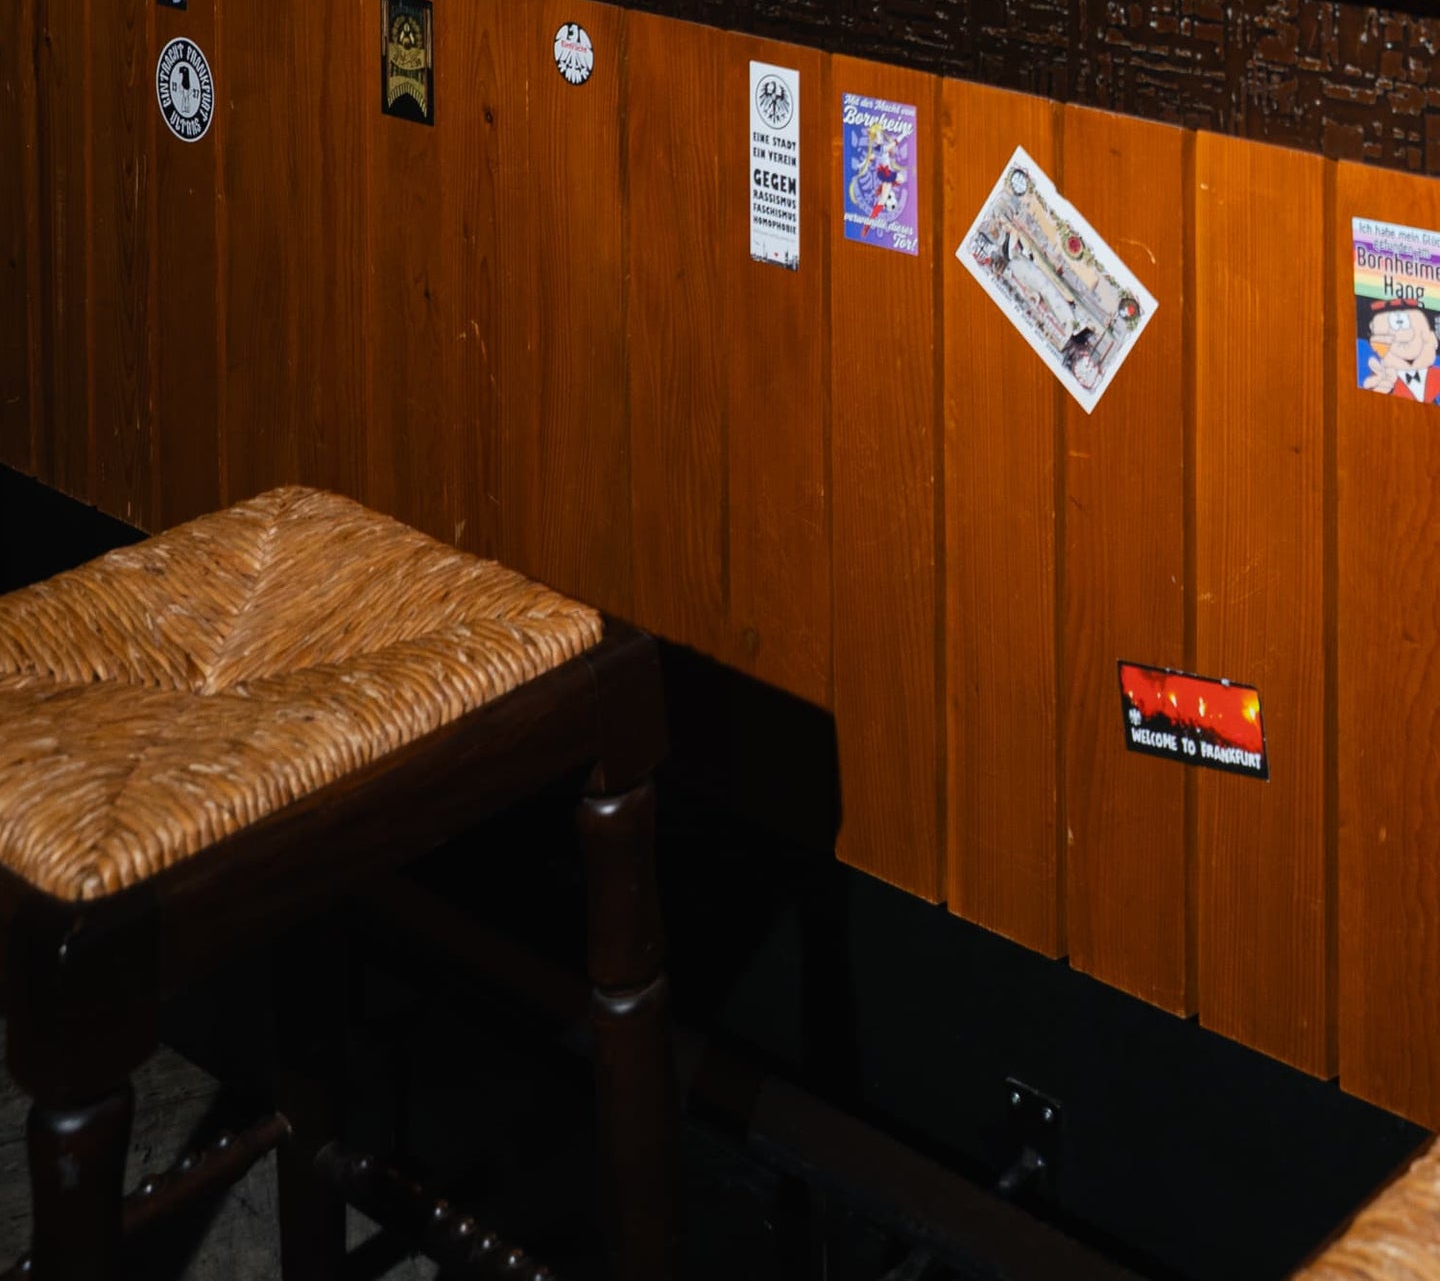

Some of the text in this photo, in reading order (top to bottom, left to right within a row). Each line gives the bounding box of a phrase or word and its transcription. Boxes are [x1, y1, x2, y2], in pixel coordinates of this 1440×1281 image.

[159, 42, 211, 122] EINTRACHT FRANKFURT
[170, 110, 202, 136] ULTRAS
[843, 105, 914, 136] Bornheim
[753, 131, 797, 151] EINE STADT
[753, 146, 797, 168] EIN VEREIN
[753, 168, 797, 195] GEGEN
[753, 189, 797, 210] RASSISMUS
[753, 202, 797, 222] FASCHISMUS
[753, 215, 797, 235] HOMOPHOBIE
[1359, 222, 1373, 235] Ich
[1374, 224, 1397, 238] habe
[1398, 229, 1420, 243] mein
[892, 233, 918, 251] Tor!
[1372, 238, 1431, 259] gefunden am
[1384, 275, 1425, 309] Hang
[1131, 727, 1261, 770] WELCOME TO FRANKFURT
